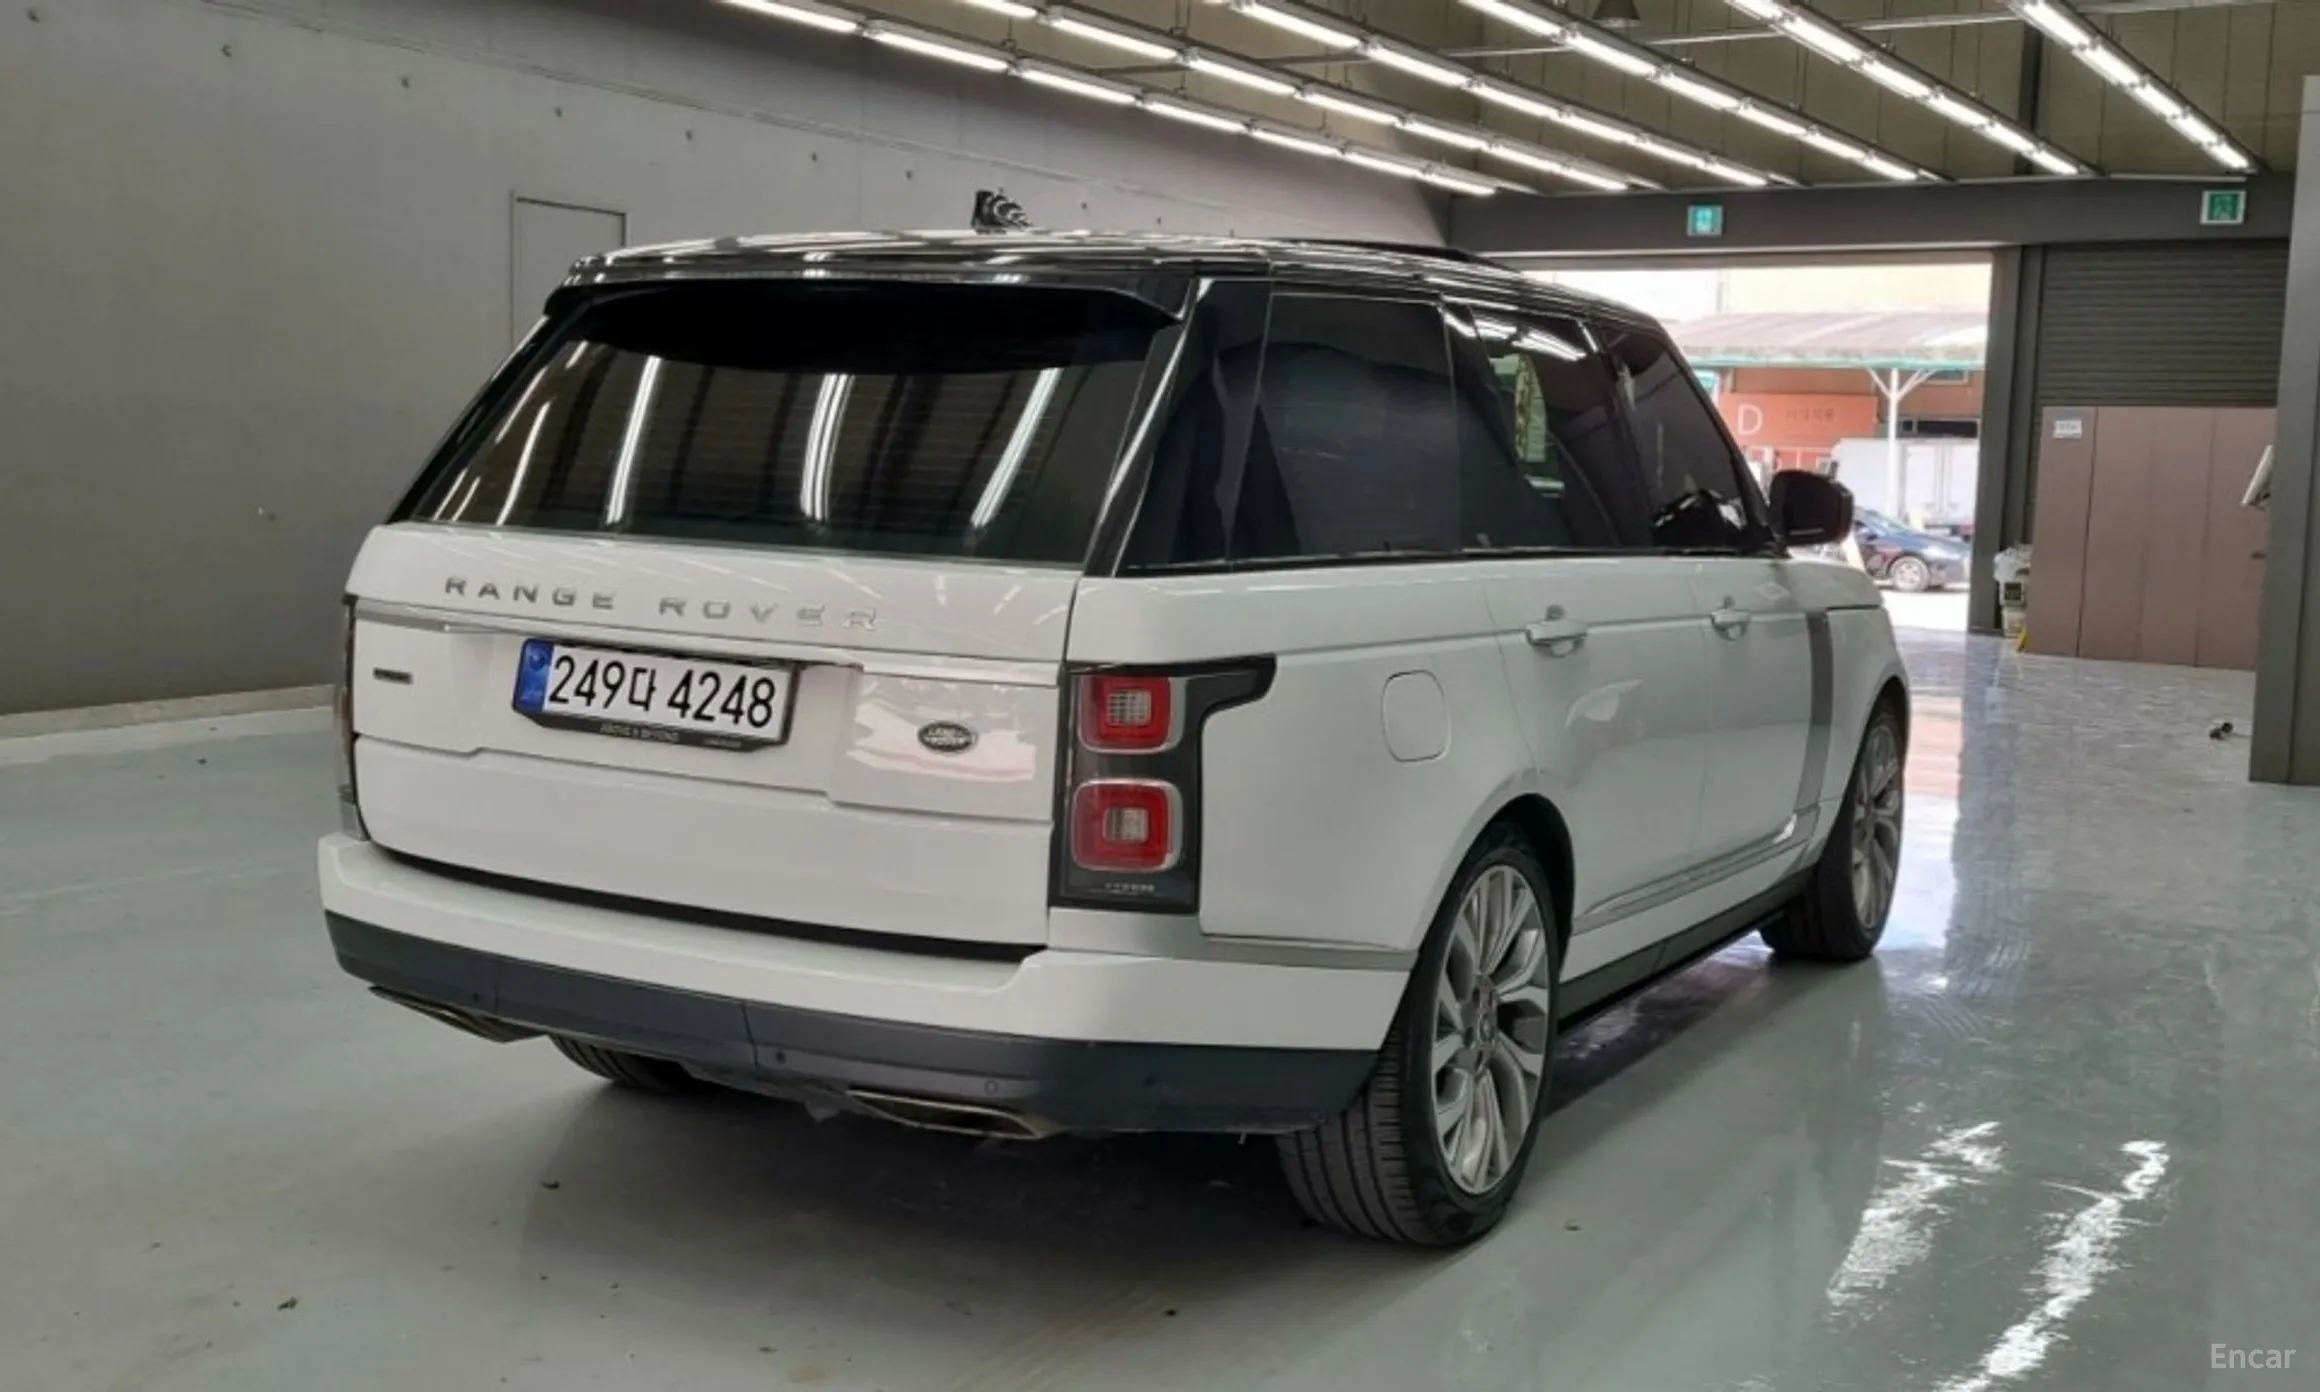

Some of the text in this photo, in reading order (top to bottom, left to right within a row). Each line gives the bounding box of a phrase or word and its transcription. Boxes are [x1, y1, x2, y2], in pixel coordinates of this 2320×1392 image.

[1738, 403, 1763, 436] D
[445, 576, 877, 631] RANGE ROVER
[548, 655, 776, 728] 249다 4248
